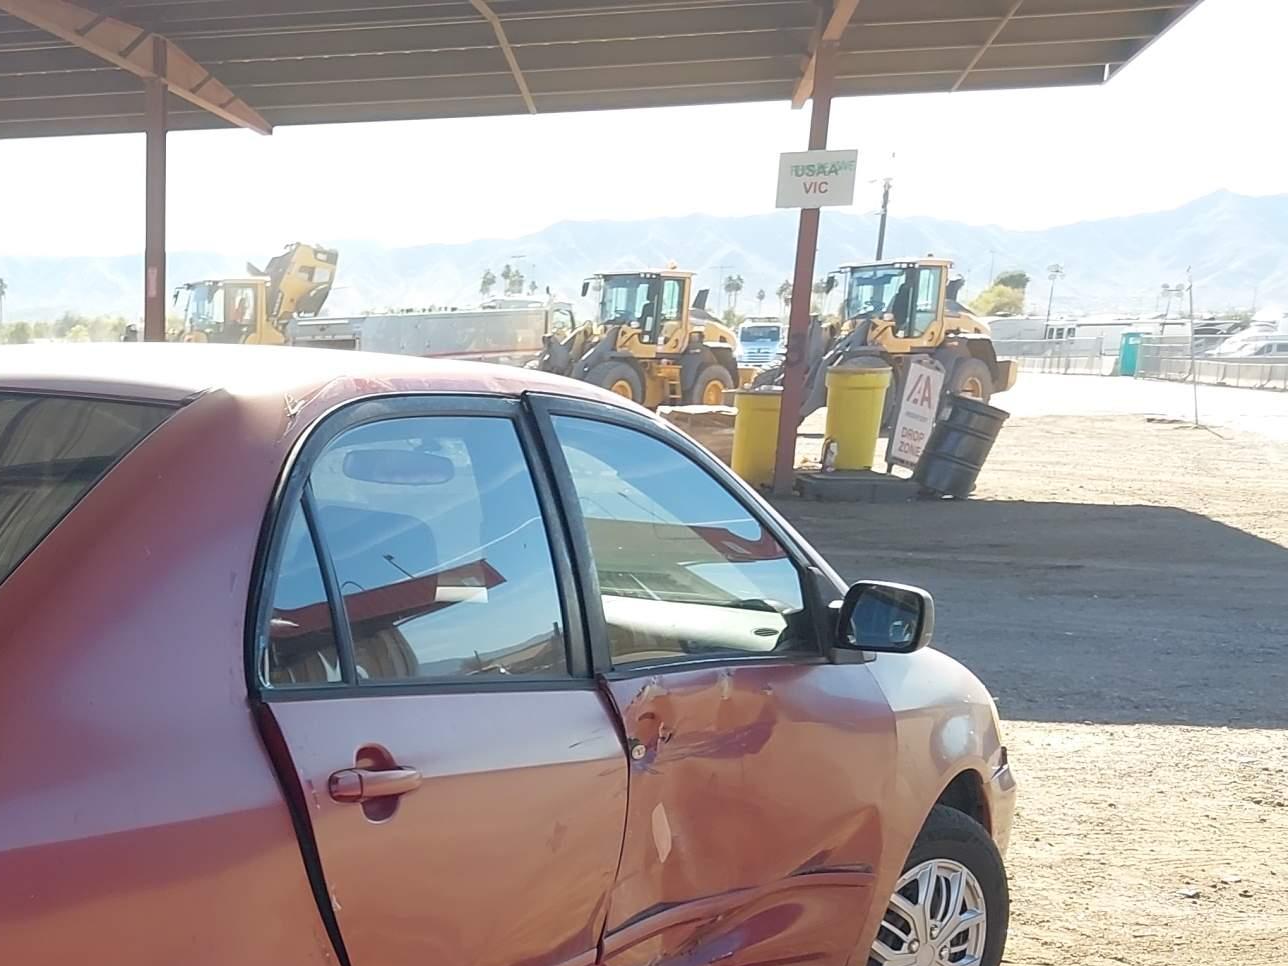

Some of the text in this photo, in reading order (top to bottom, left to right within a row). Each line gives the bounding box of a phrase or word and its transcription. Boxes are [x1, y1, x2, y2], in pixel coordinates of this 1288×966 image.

[802, 181, 829, 194] VIC
[900, 426, 925, 441] DROP
[898, 441, 922, 457] ZONE
